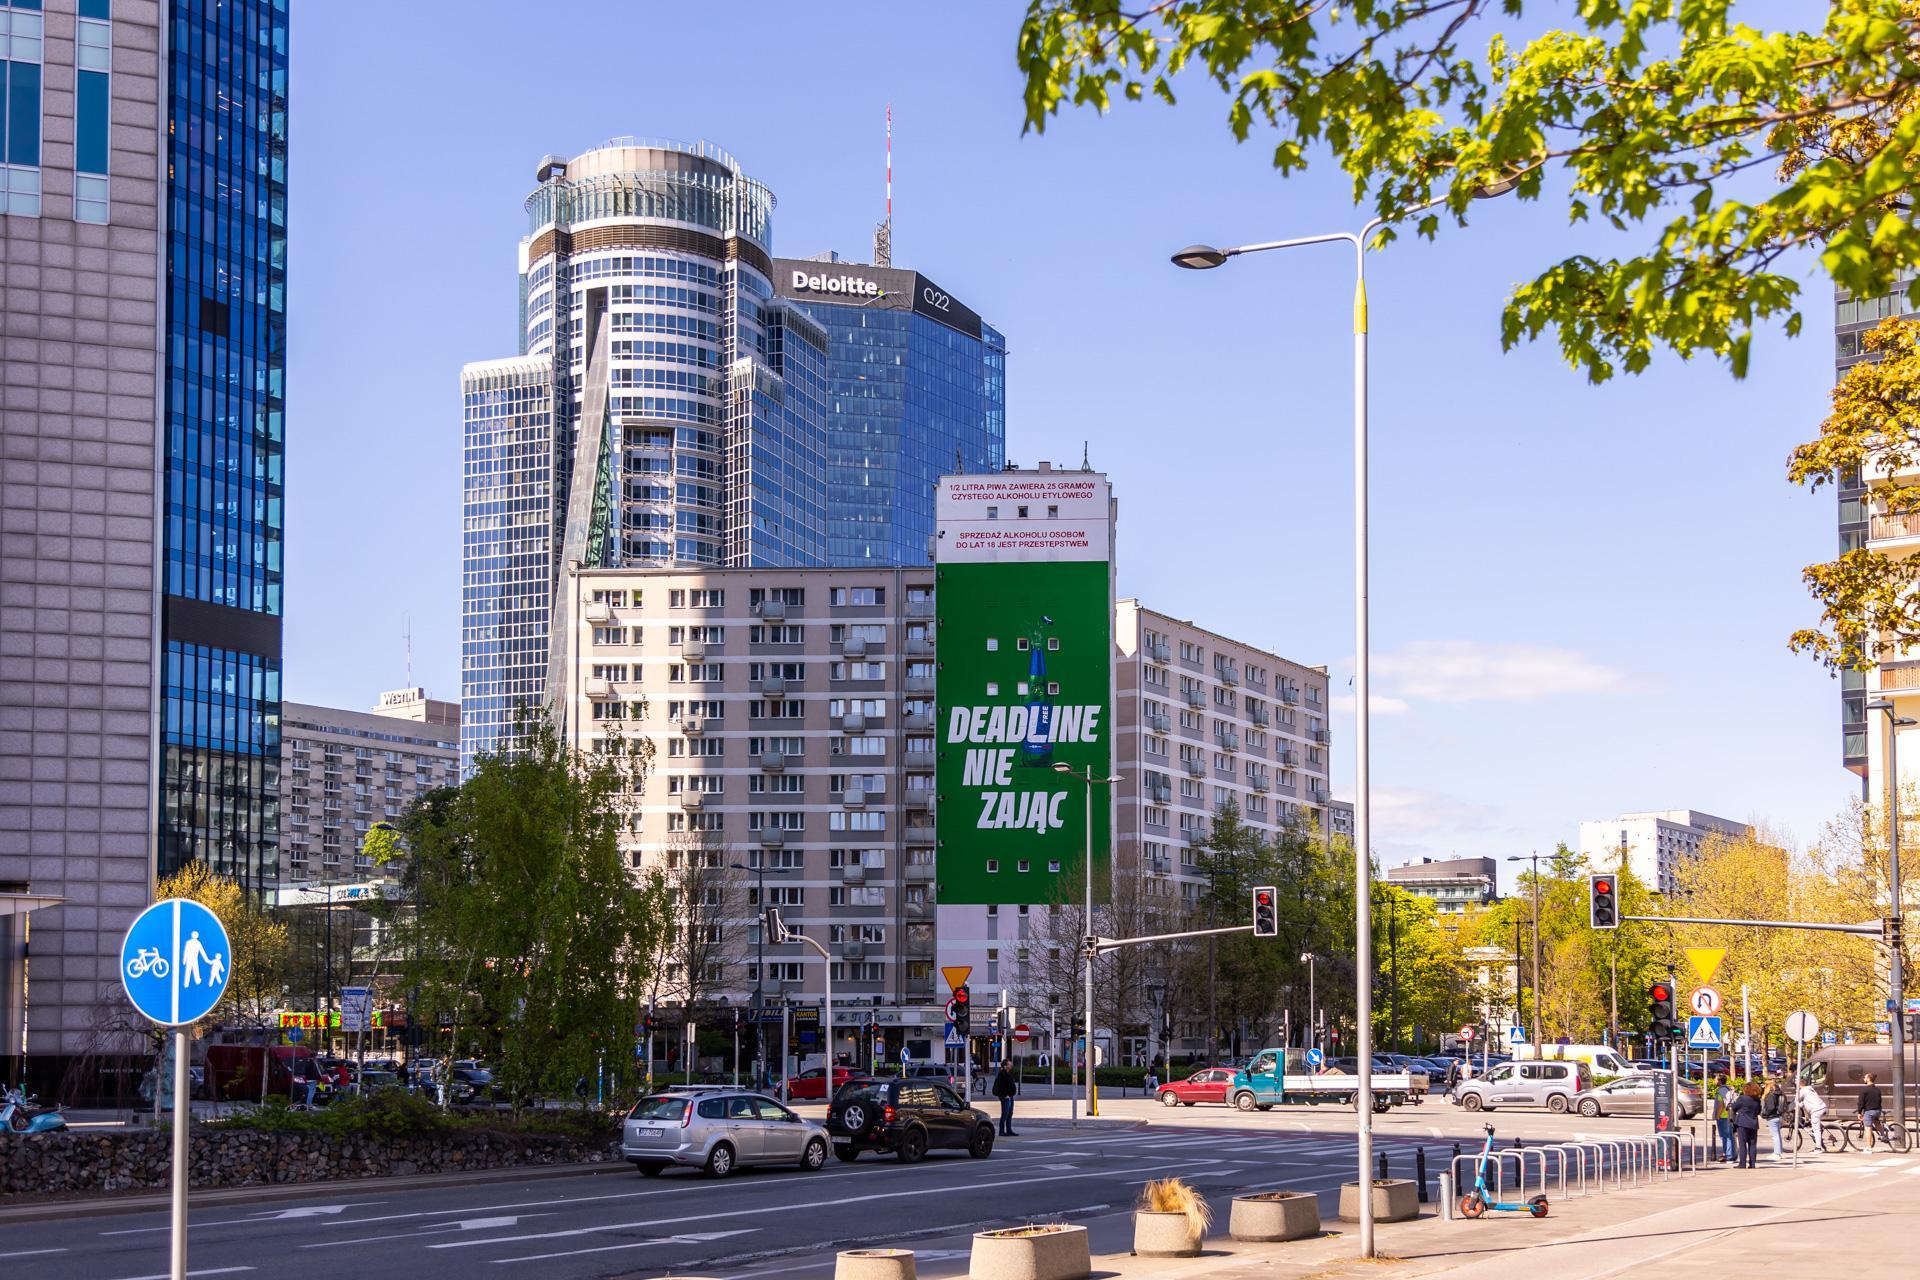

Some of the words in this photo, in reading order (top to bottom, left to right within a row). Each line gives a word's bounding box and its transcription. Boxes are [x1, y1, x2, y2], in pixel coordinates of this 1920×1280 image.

[792, 271, 884, 296] Deloitte.
[923, 287, 949, 312] Q22
[951, 493, 995, 501] CZYSTEGO
[996, 492, 1040, 500] ALKOHOLU
[1042, 491, 1093, 499] ETYLOWEGO
[986, 483, 1008, 491] PIWA
[1047, 482, 1057, 490] 25
[1058, 481, 1096, 490] GRAMÓW
[959, 530, 1002, 539] SPRZEDAŻ
[1003, 531, 1047, 539] ALKOHOLU
[1019, 540, 1089, 549] PRZESTĘPSTWEM
[948, 705, 1101, 743] DEADLINE
[962, 749, 1016, 785] NIE
[976, 791, 1068, 834] ZAJĄC
